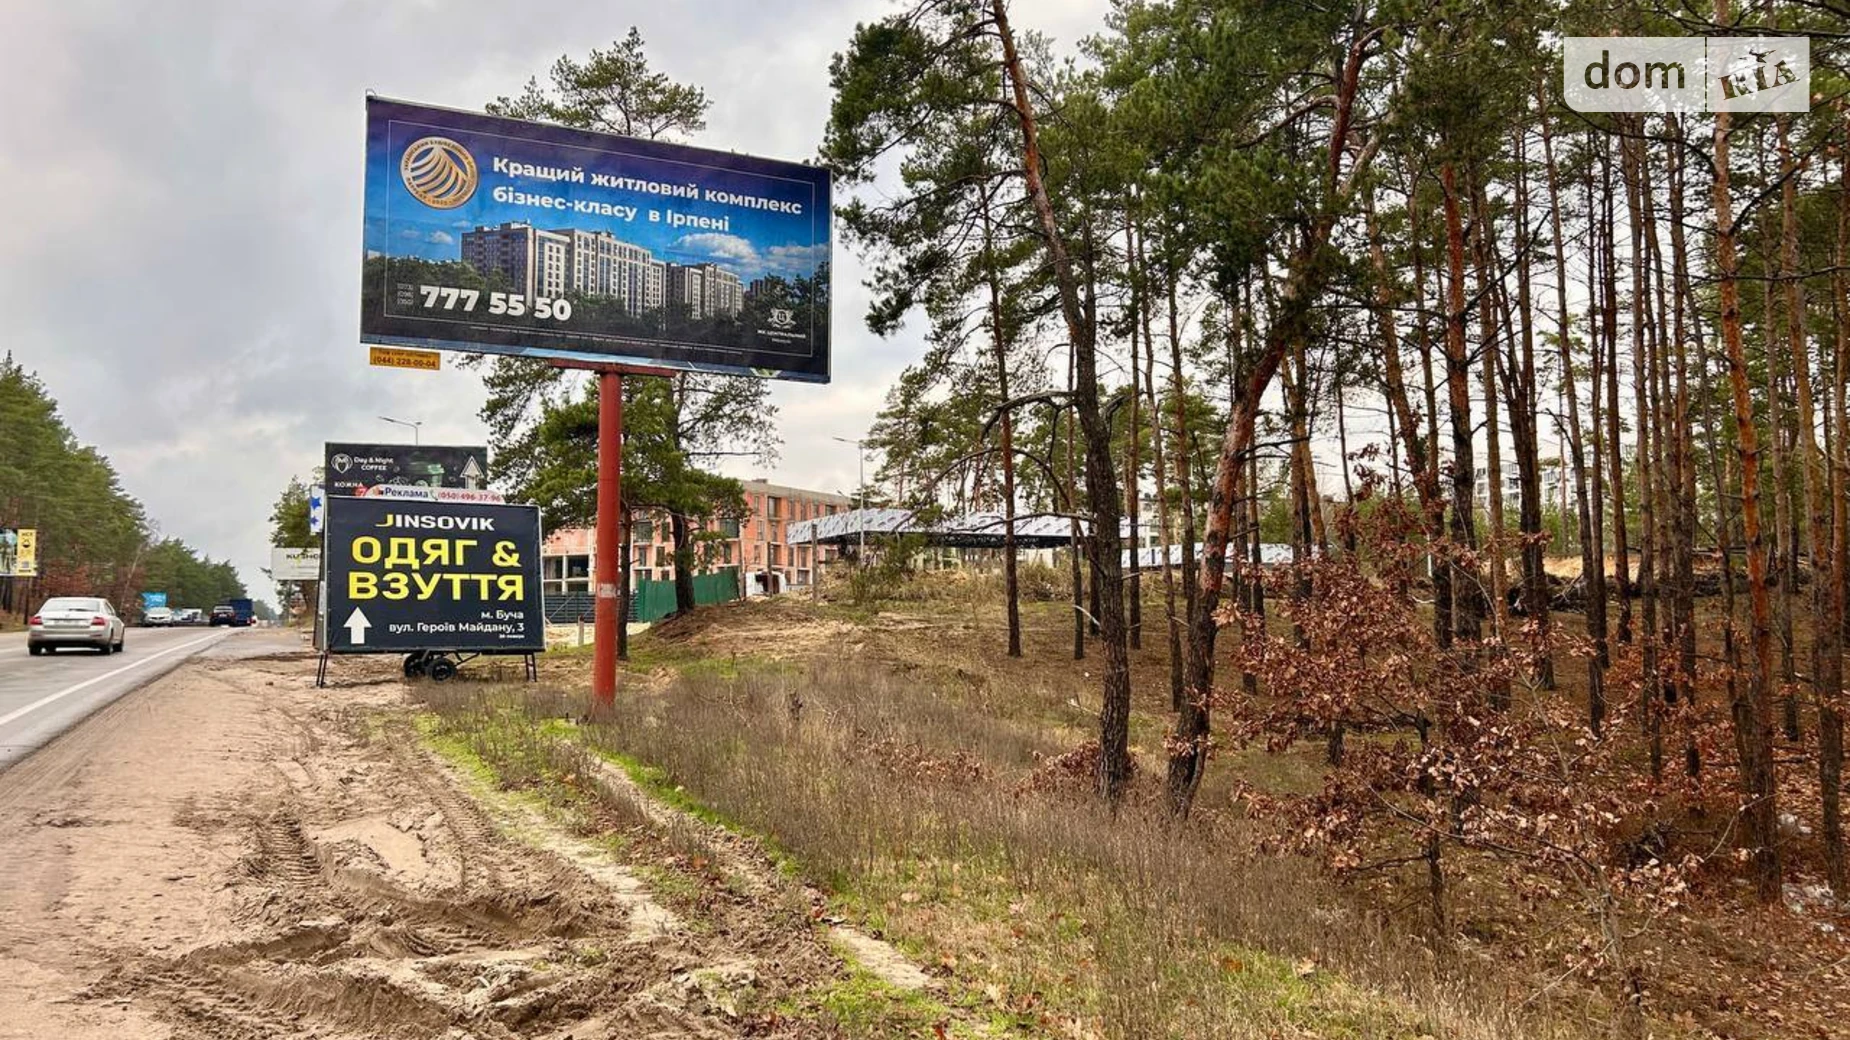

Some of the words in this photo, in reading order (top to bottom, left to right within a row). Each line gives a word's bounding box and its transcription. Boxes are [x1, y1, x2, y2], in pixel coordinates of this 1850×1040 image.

[493, 157, 584, 184] Кращий
[591, 173, 698, 200] житловий
[705, 189, 802, 214] комплекс
[493, 187, 638, 222] бізнес-класу
[648, 209, 660, 222] в
[666, 209, 729, 232] Ірпені
[419, 285, 480, 312] 777
[488, 291, 526, 316] 55
[533, 297, 572, 321] 50
[384, 487, 429, 499] Реклама
[375, 514, 495, 531] JINSOVIK
[352, 536, 478, 570] ОДЯГ
[492, 541, 522, 567] &
[348, 571, 524, 601] ВЗУТТЯ
[389, 623, 414, 634] вул.
[417, 622, 456, 633] Героїв
[459, 622, 515, 633] Майдану,
[517, 623, 525, 632] 3
[481, 611, 494, 619] м.
[496, 609, 524, 621] Буча
